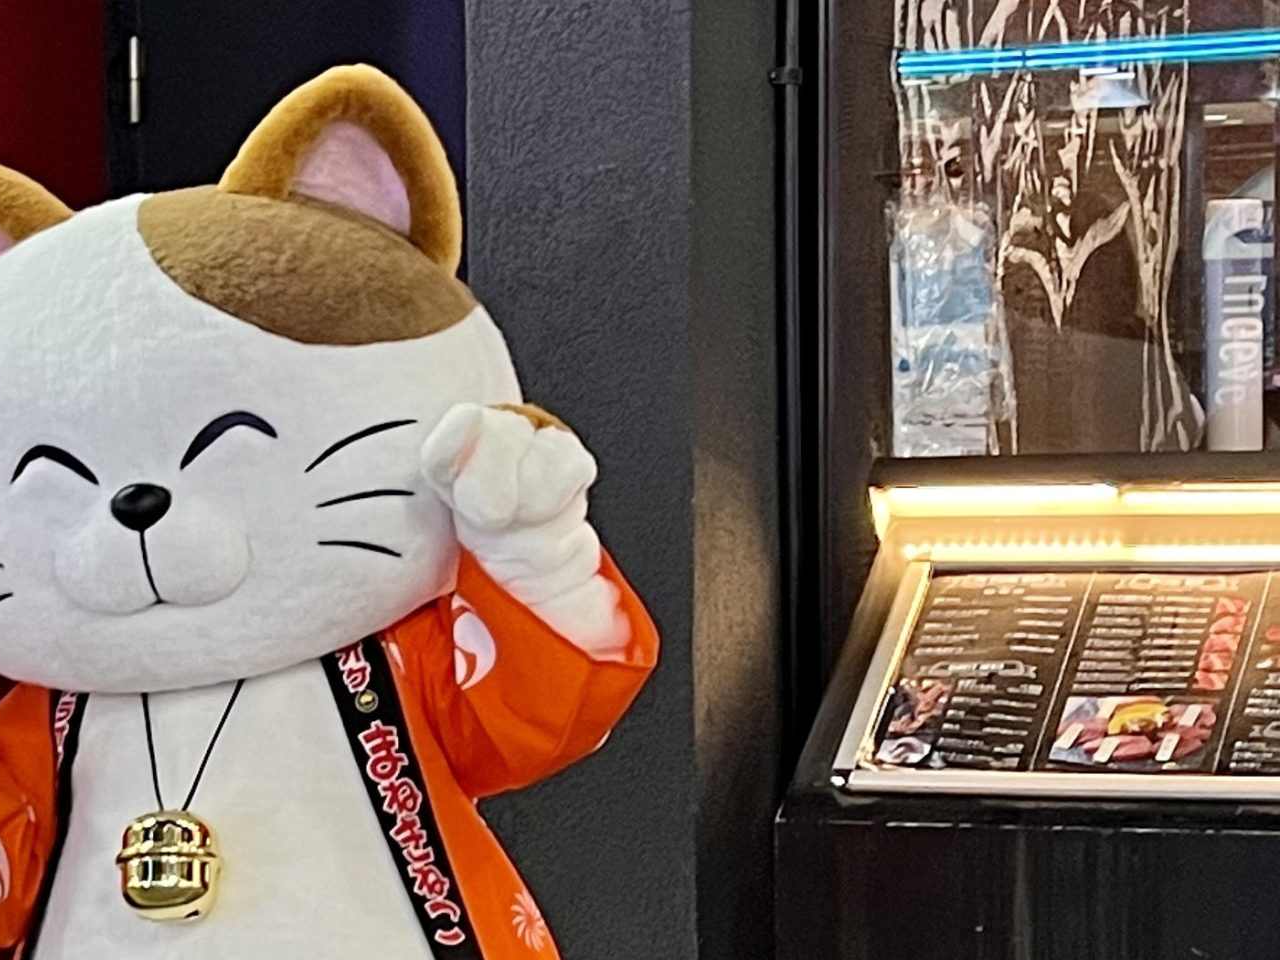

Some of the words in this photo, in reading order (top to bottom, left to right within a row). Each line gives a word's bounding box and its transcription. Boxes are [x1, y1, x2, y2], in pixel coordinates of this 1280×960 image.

[358, 719, 466, 946] まねきねこ
